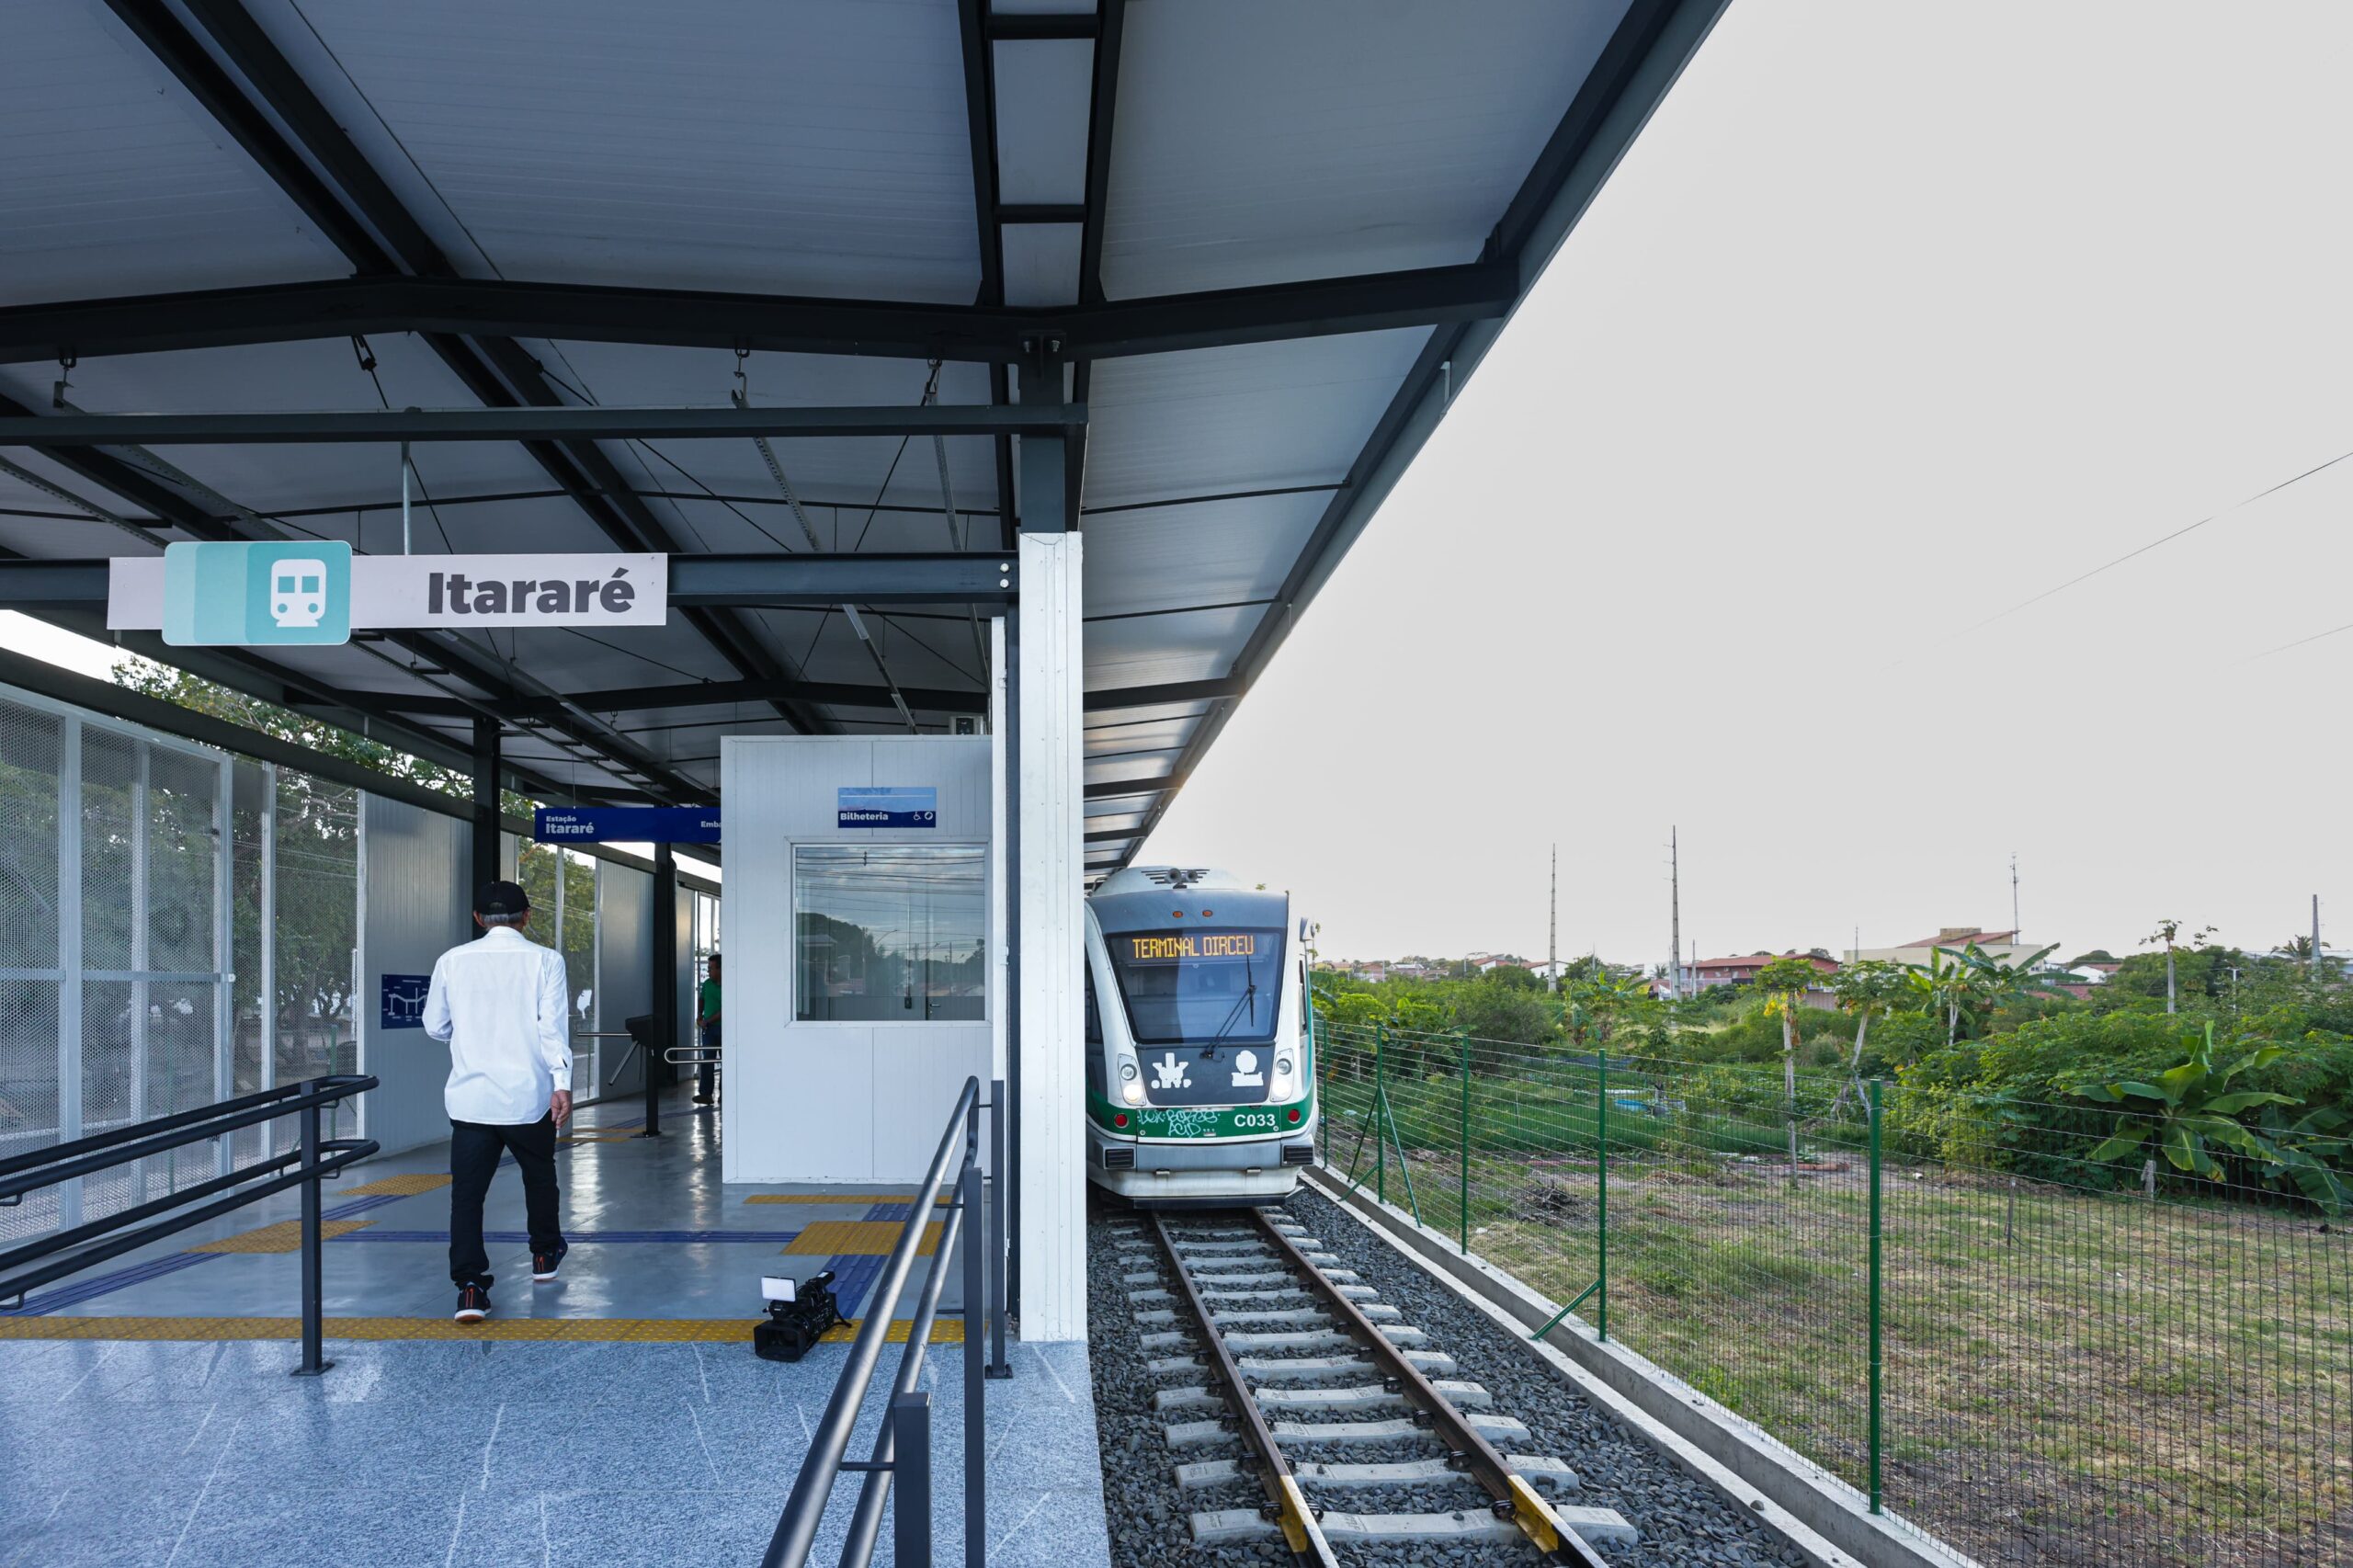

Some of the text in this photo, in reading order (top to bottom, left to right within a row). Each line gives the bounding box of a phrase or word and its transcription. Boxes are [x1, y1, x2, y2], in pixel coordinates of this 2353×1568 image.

[428, 567, 636, 614] Itararé
[546, 815, 576, 824] Estação
[840, 812, 889, 821] Bilheteria
[546, 822, 594, 834] Itararé
[1132, 935, 1254, 958] TERMINAL DIRCEU
[1234, 1114, 1276, 1127] C033
